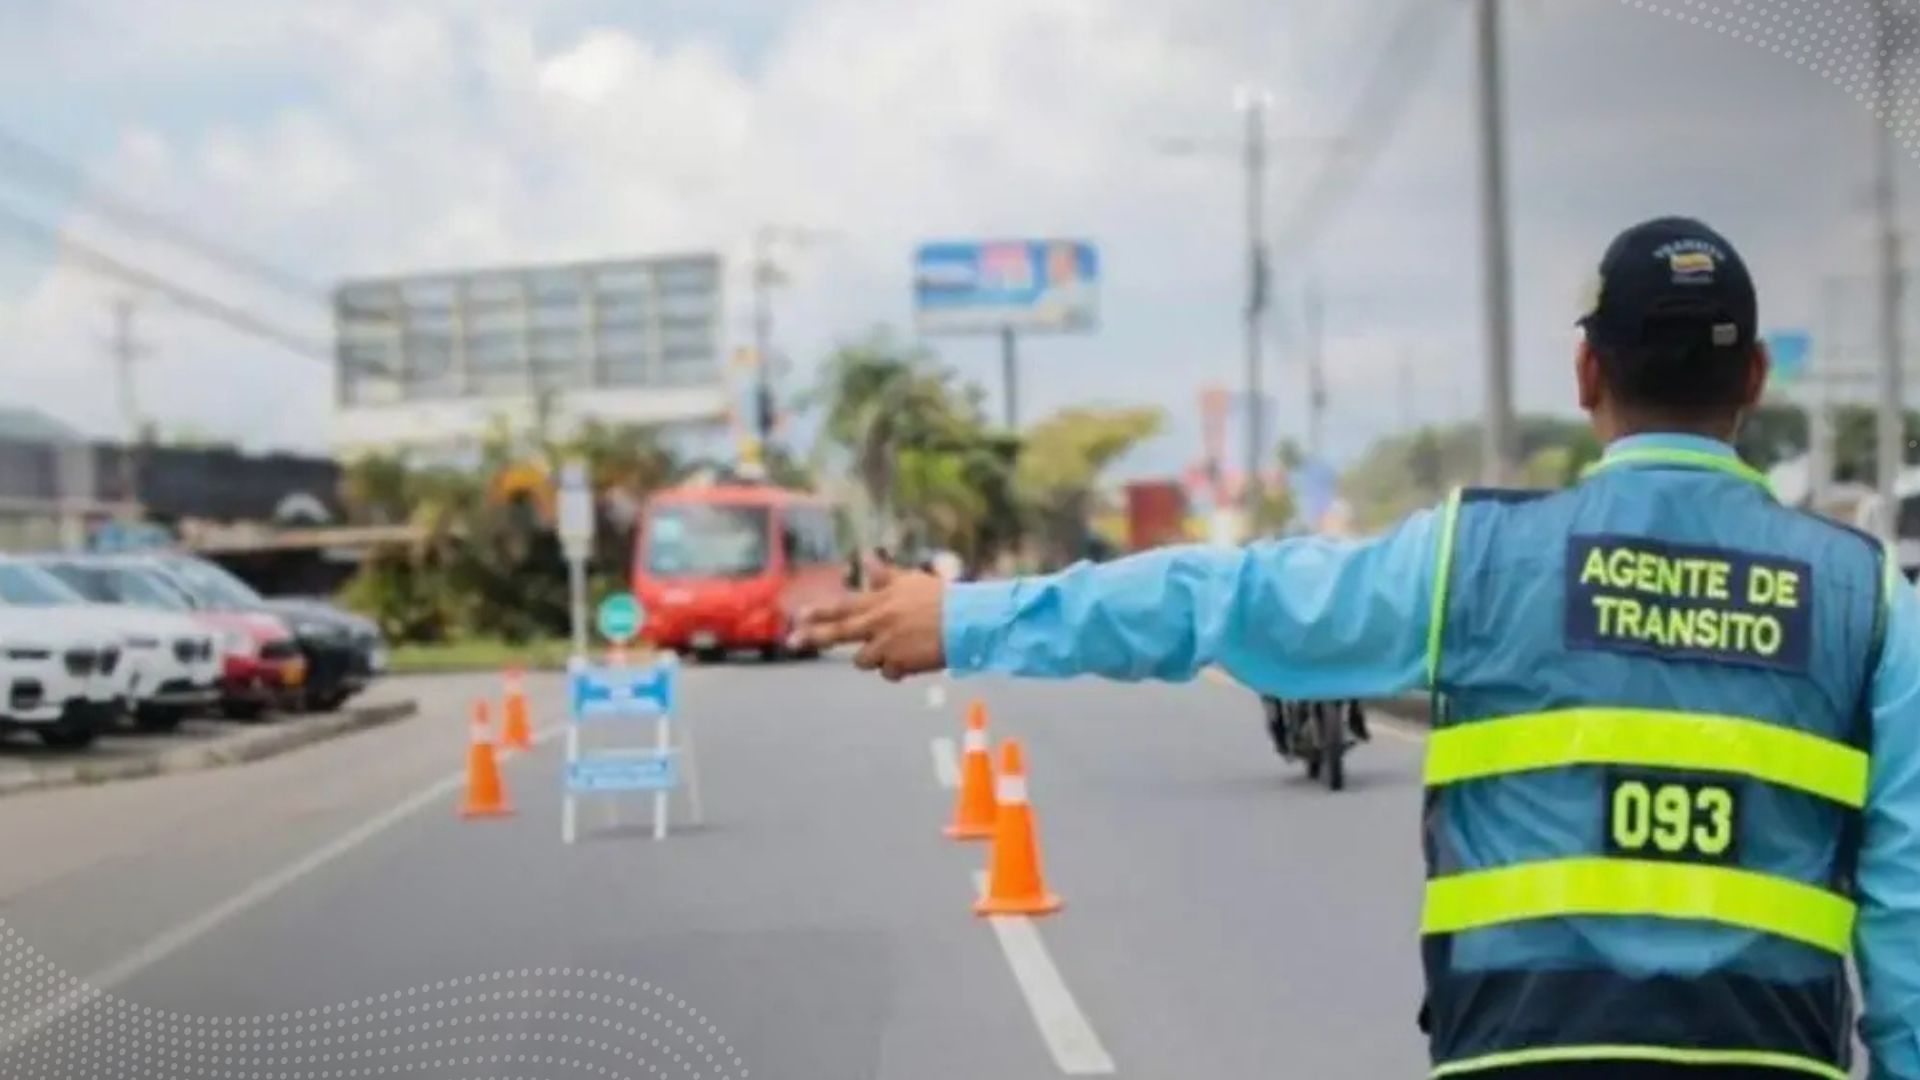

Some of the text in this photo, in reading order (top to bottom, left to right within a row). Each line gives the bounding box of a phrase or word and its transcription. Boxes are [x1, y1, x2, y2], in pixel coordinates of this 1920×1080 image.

[1580, 547, 1799, 607] AGENTE DE
[1592, 596, 1782, 654] TRANSITO
[1612, 781, 1733, 853] 093
